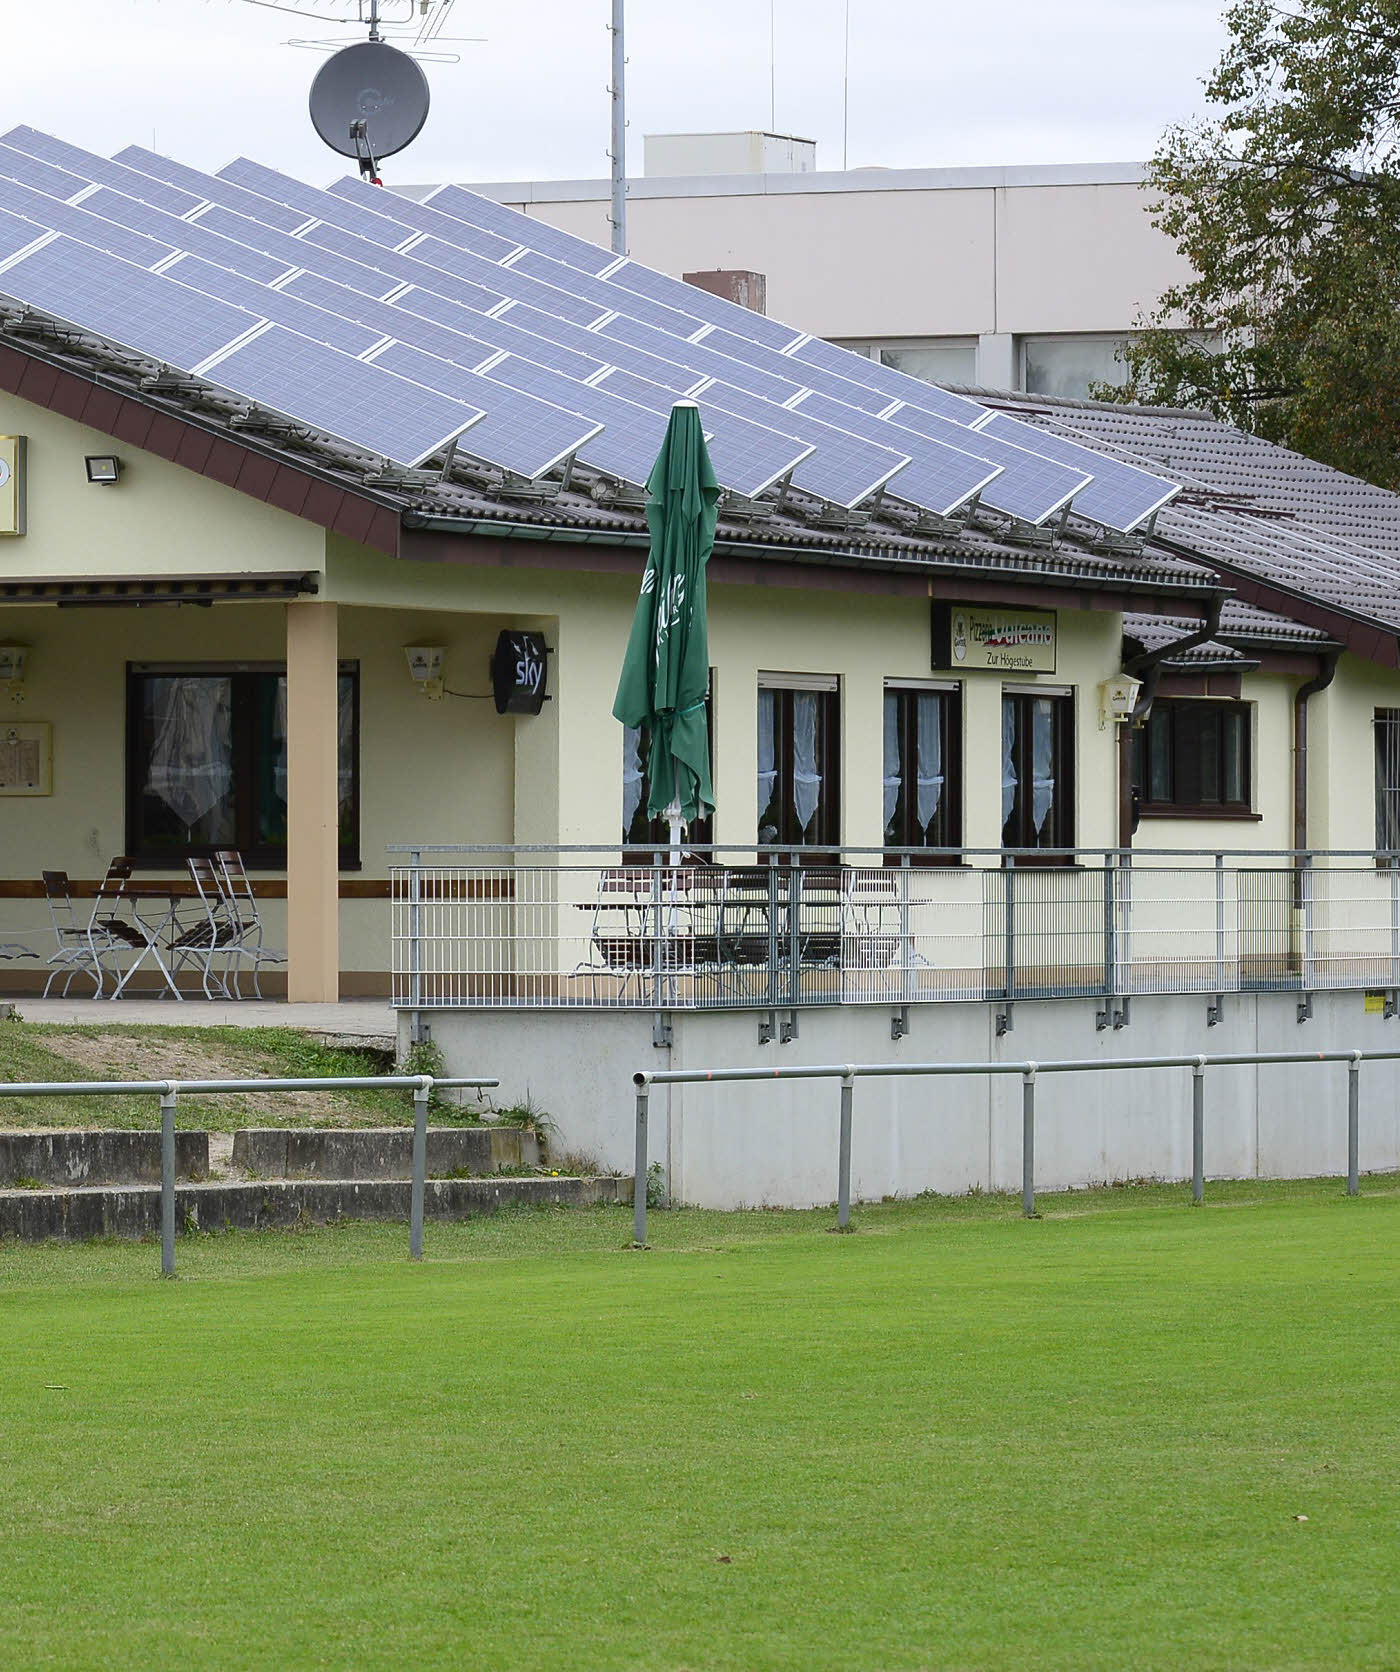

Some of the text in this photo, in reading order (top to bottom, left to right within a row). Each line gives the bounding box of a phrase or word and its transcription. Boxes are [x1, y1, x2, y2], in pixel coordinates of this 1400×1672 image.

[993, 617, 1053, 646] Vulcano
[515, 654, 543, 695] sky
[987, 651, 1033, 669] Zur Högestube
